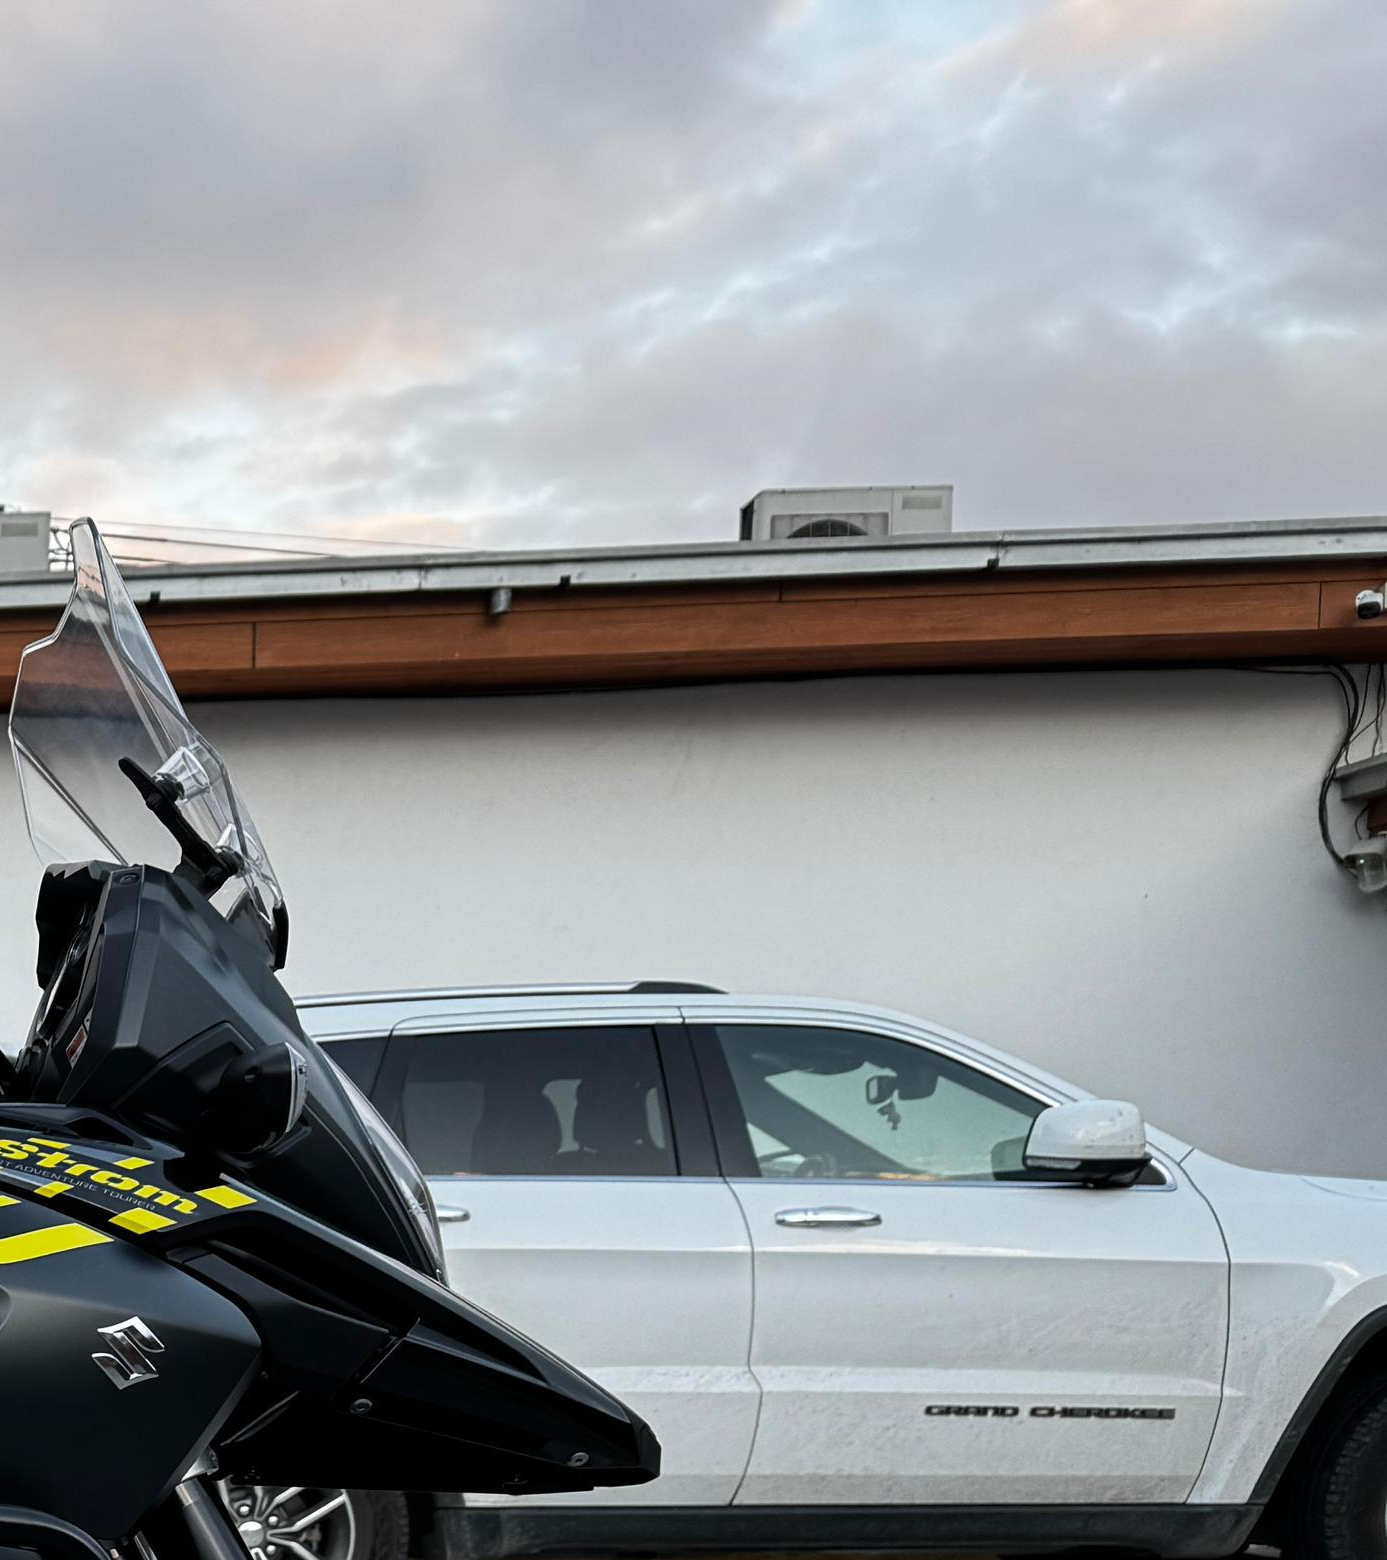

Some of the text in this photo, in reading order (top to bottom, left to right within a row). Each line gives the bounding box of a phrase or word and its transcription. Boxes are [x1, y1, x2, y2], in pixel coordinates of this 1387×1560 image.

[14, 1162, 98, 1192] ADVENTURE
[103, 1186, 157, 1212] TOURER
[924, 1404, 1176, 1420] GRAND CHEROKEE
